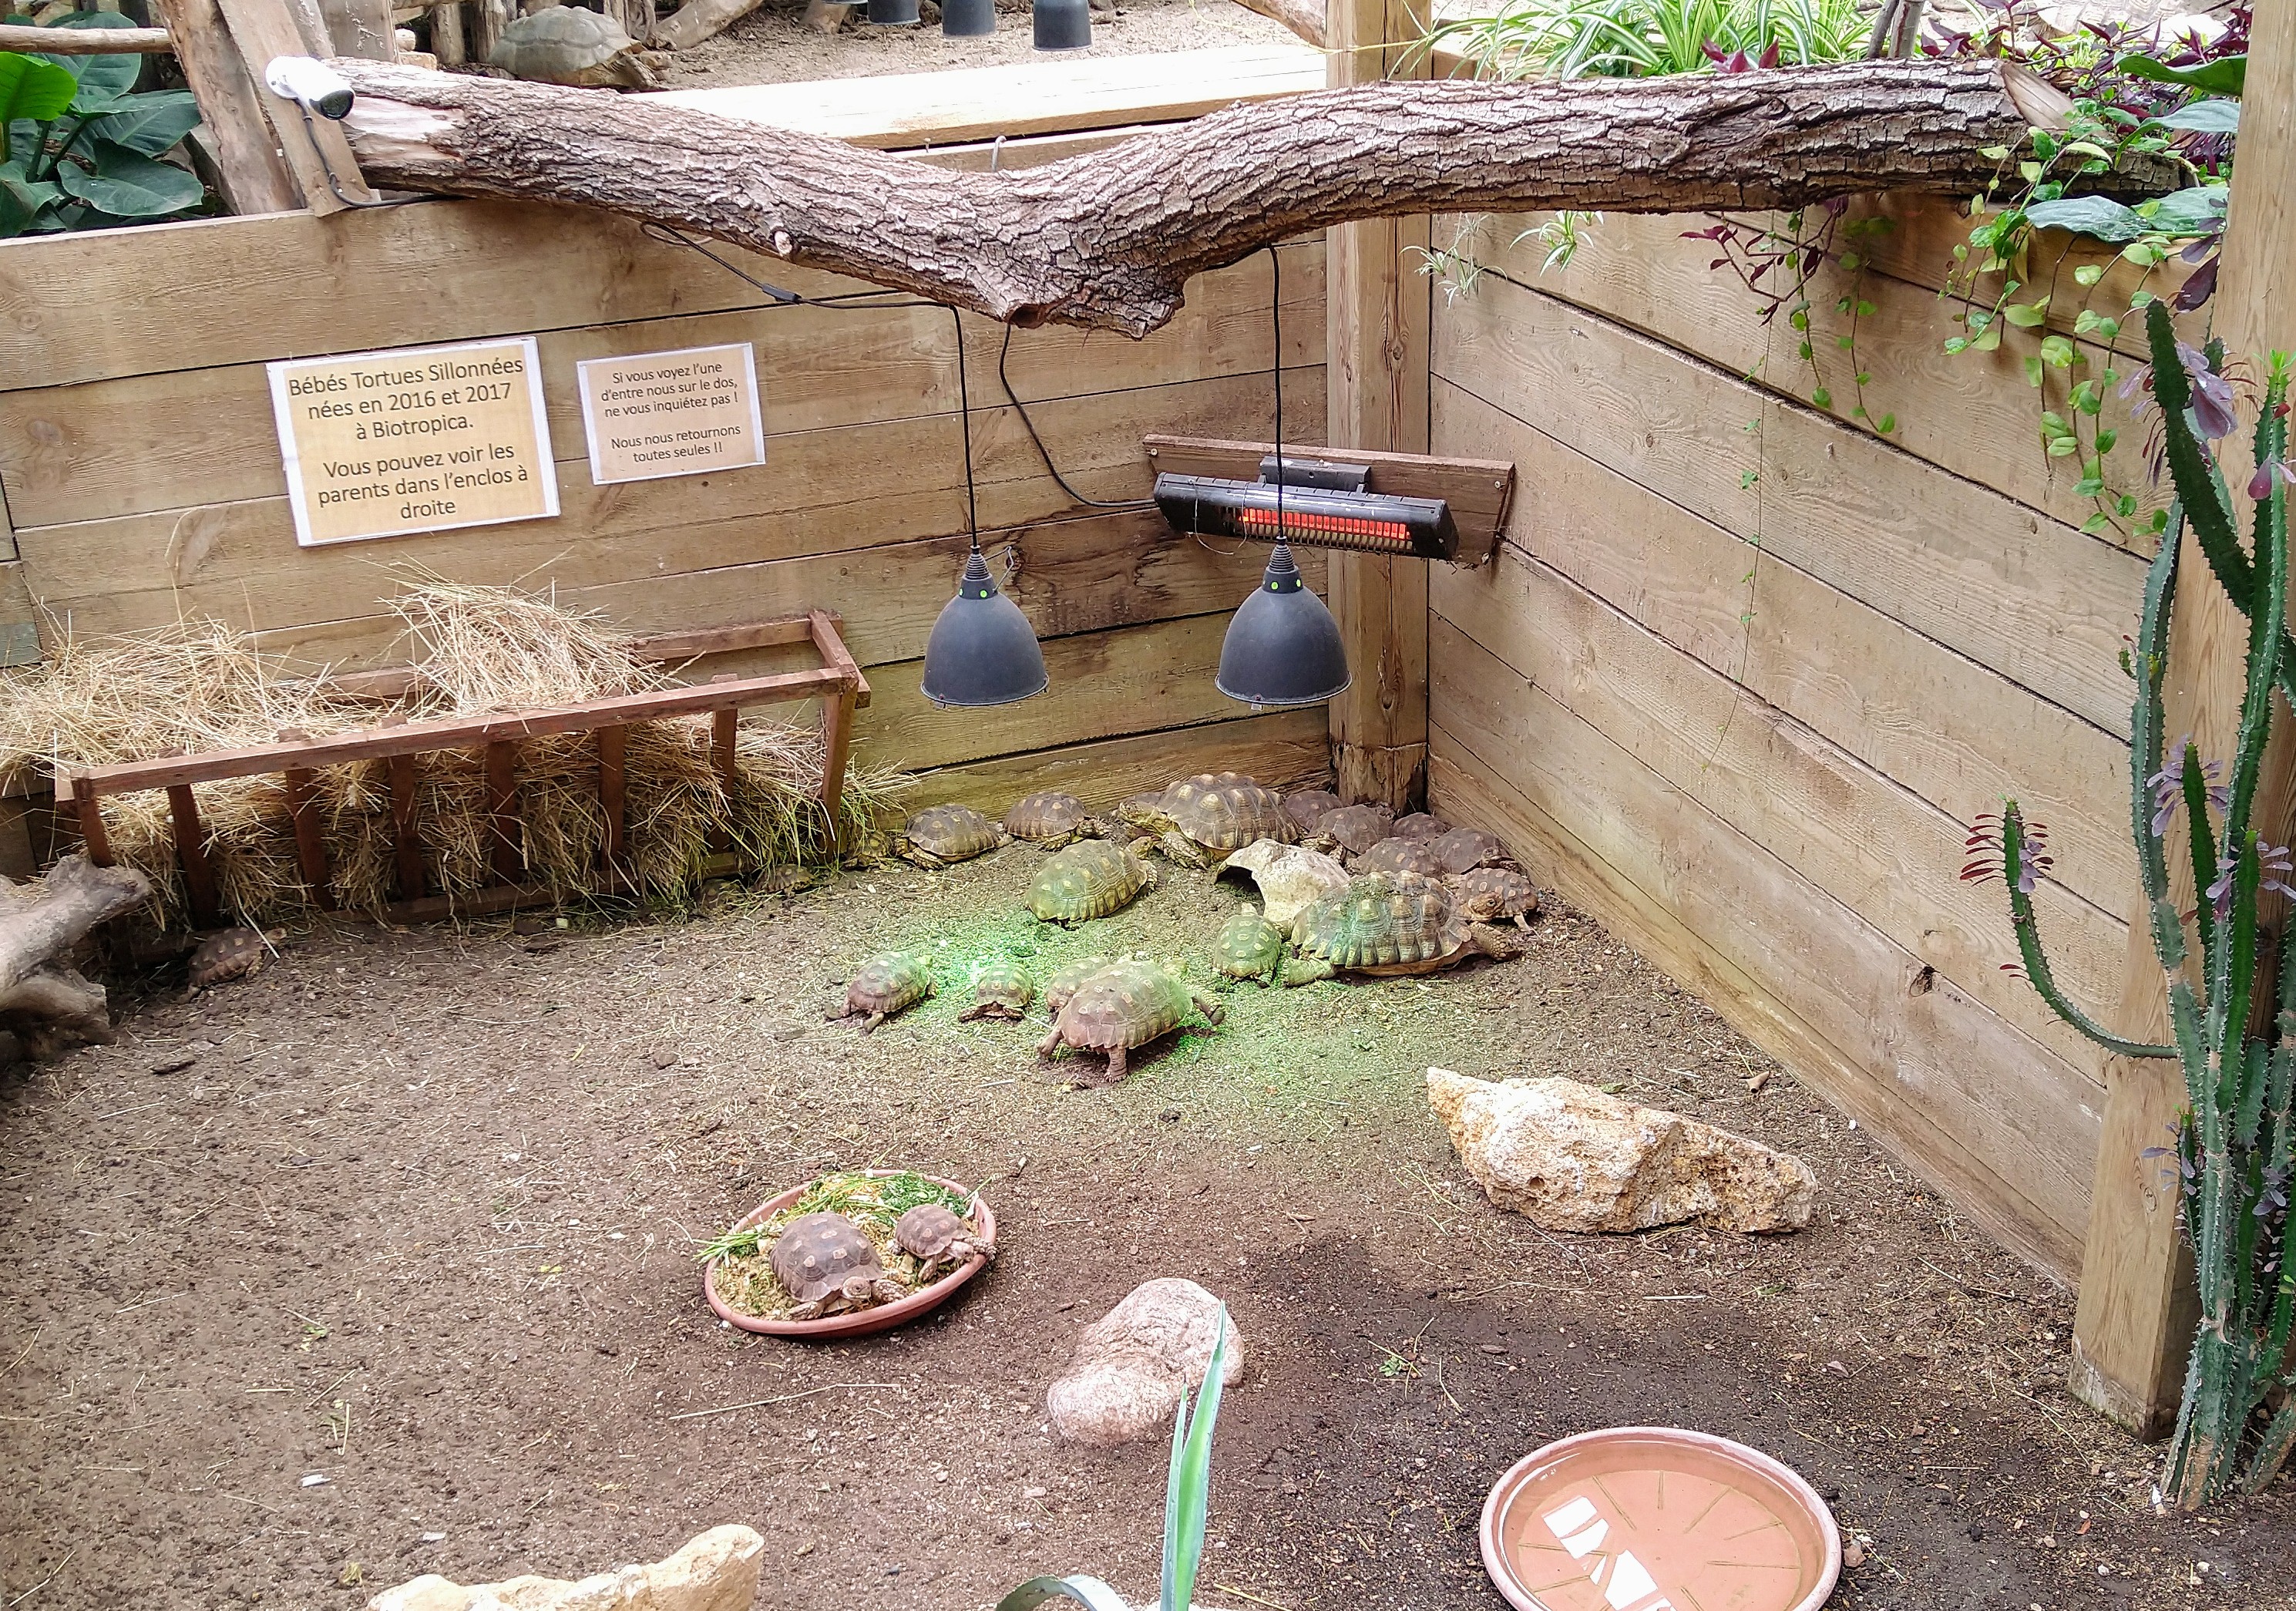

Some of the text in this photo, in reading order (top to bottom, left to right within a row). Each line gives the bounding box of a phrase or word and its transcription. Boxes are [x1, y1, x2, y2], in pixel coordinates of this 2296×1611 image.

[289, 358, 523, 396] Bébés Tortues Sillonnées
[613, 372, 623, 383] Si
[626, 371, 654, 382] vous
[657, 368, 691, 379] voyez
[647, 385, 675, 396] nous
[679, 382, 697, 392] sur
[701, 379, 711, 390] le
[714, 378, 738, 388] dos,
[308, 383, 511, 419] nées en 2016 et 2017
[605, 392, 738, 417] ne vous inquiétez pas !
[356, 415, 473, 439] à Biotropica.
[611, 425, 741, 449] Nous nous retournons
[323, 444, 514, 478] Vous pouvez voir les
[633, 442, 723, 462] toutes seules !!
[318, 484, 390, 507] parents
[396, 478, 439, 495] dans
[518, 465, 528, 481] à
[401, 500, 456, 519] droite
